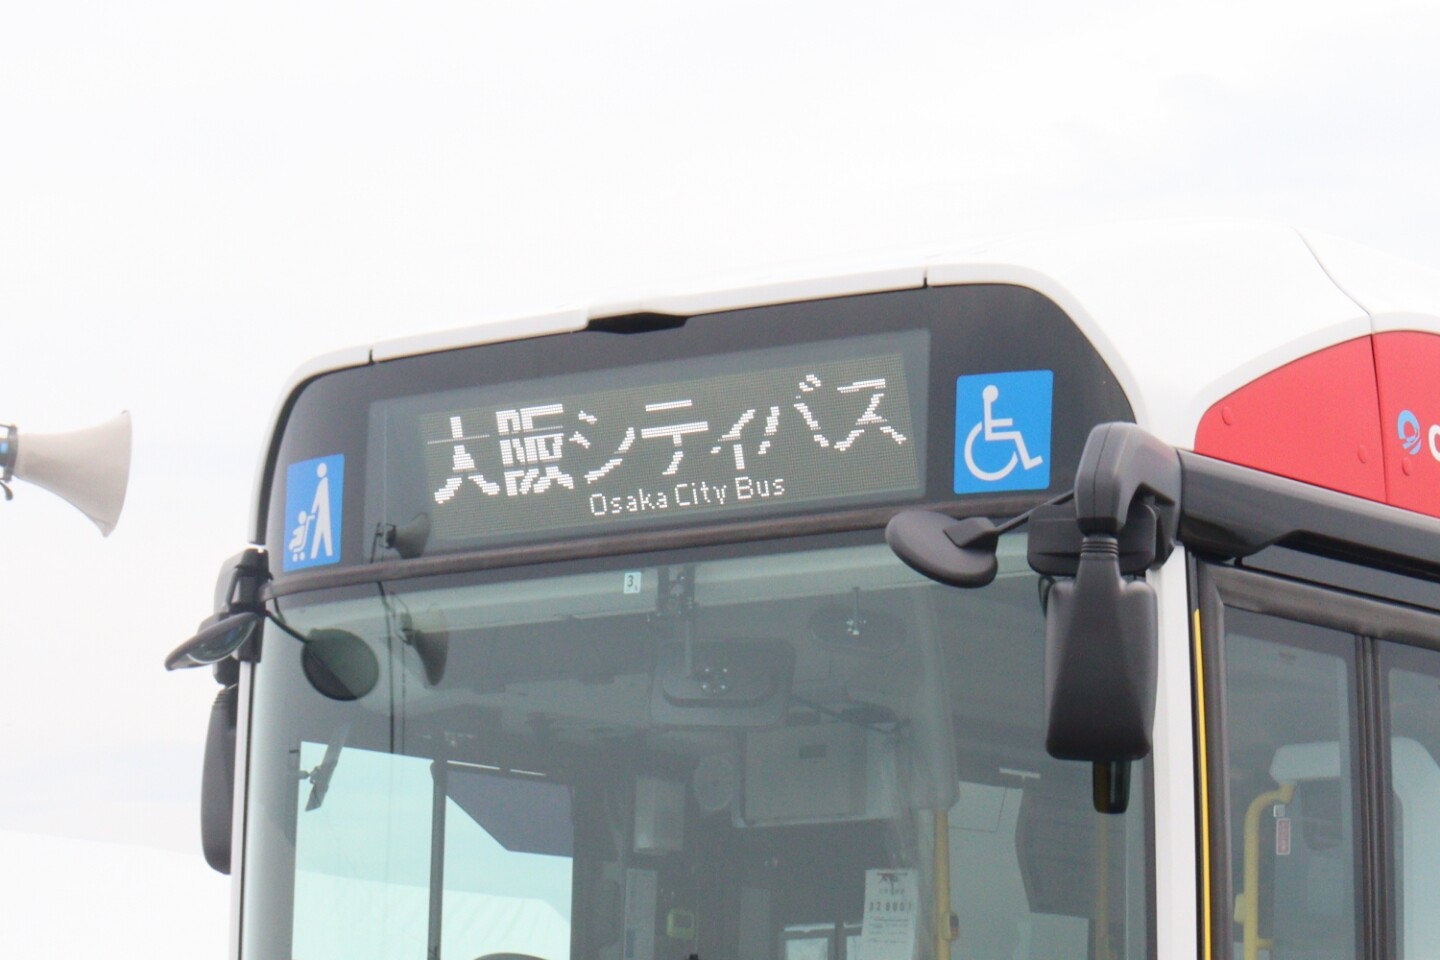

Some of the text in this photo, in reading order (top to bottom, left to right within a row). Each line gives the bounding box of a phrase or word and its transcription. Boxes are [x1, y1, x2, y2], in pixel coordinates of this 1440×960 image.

[427, 374, 907, 504] 大阪シティバス
[589, 477, 786, 516] Osaka City Bus
